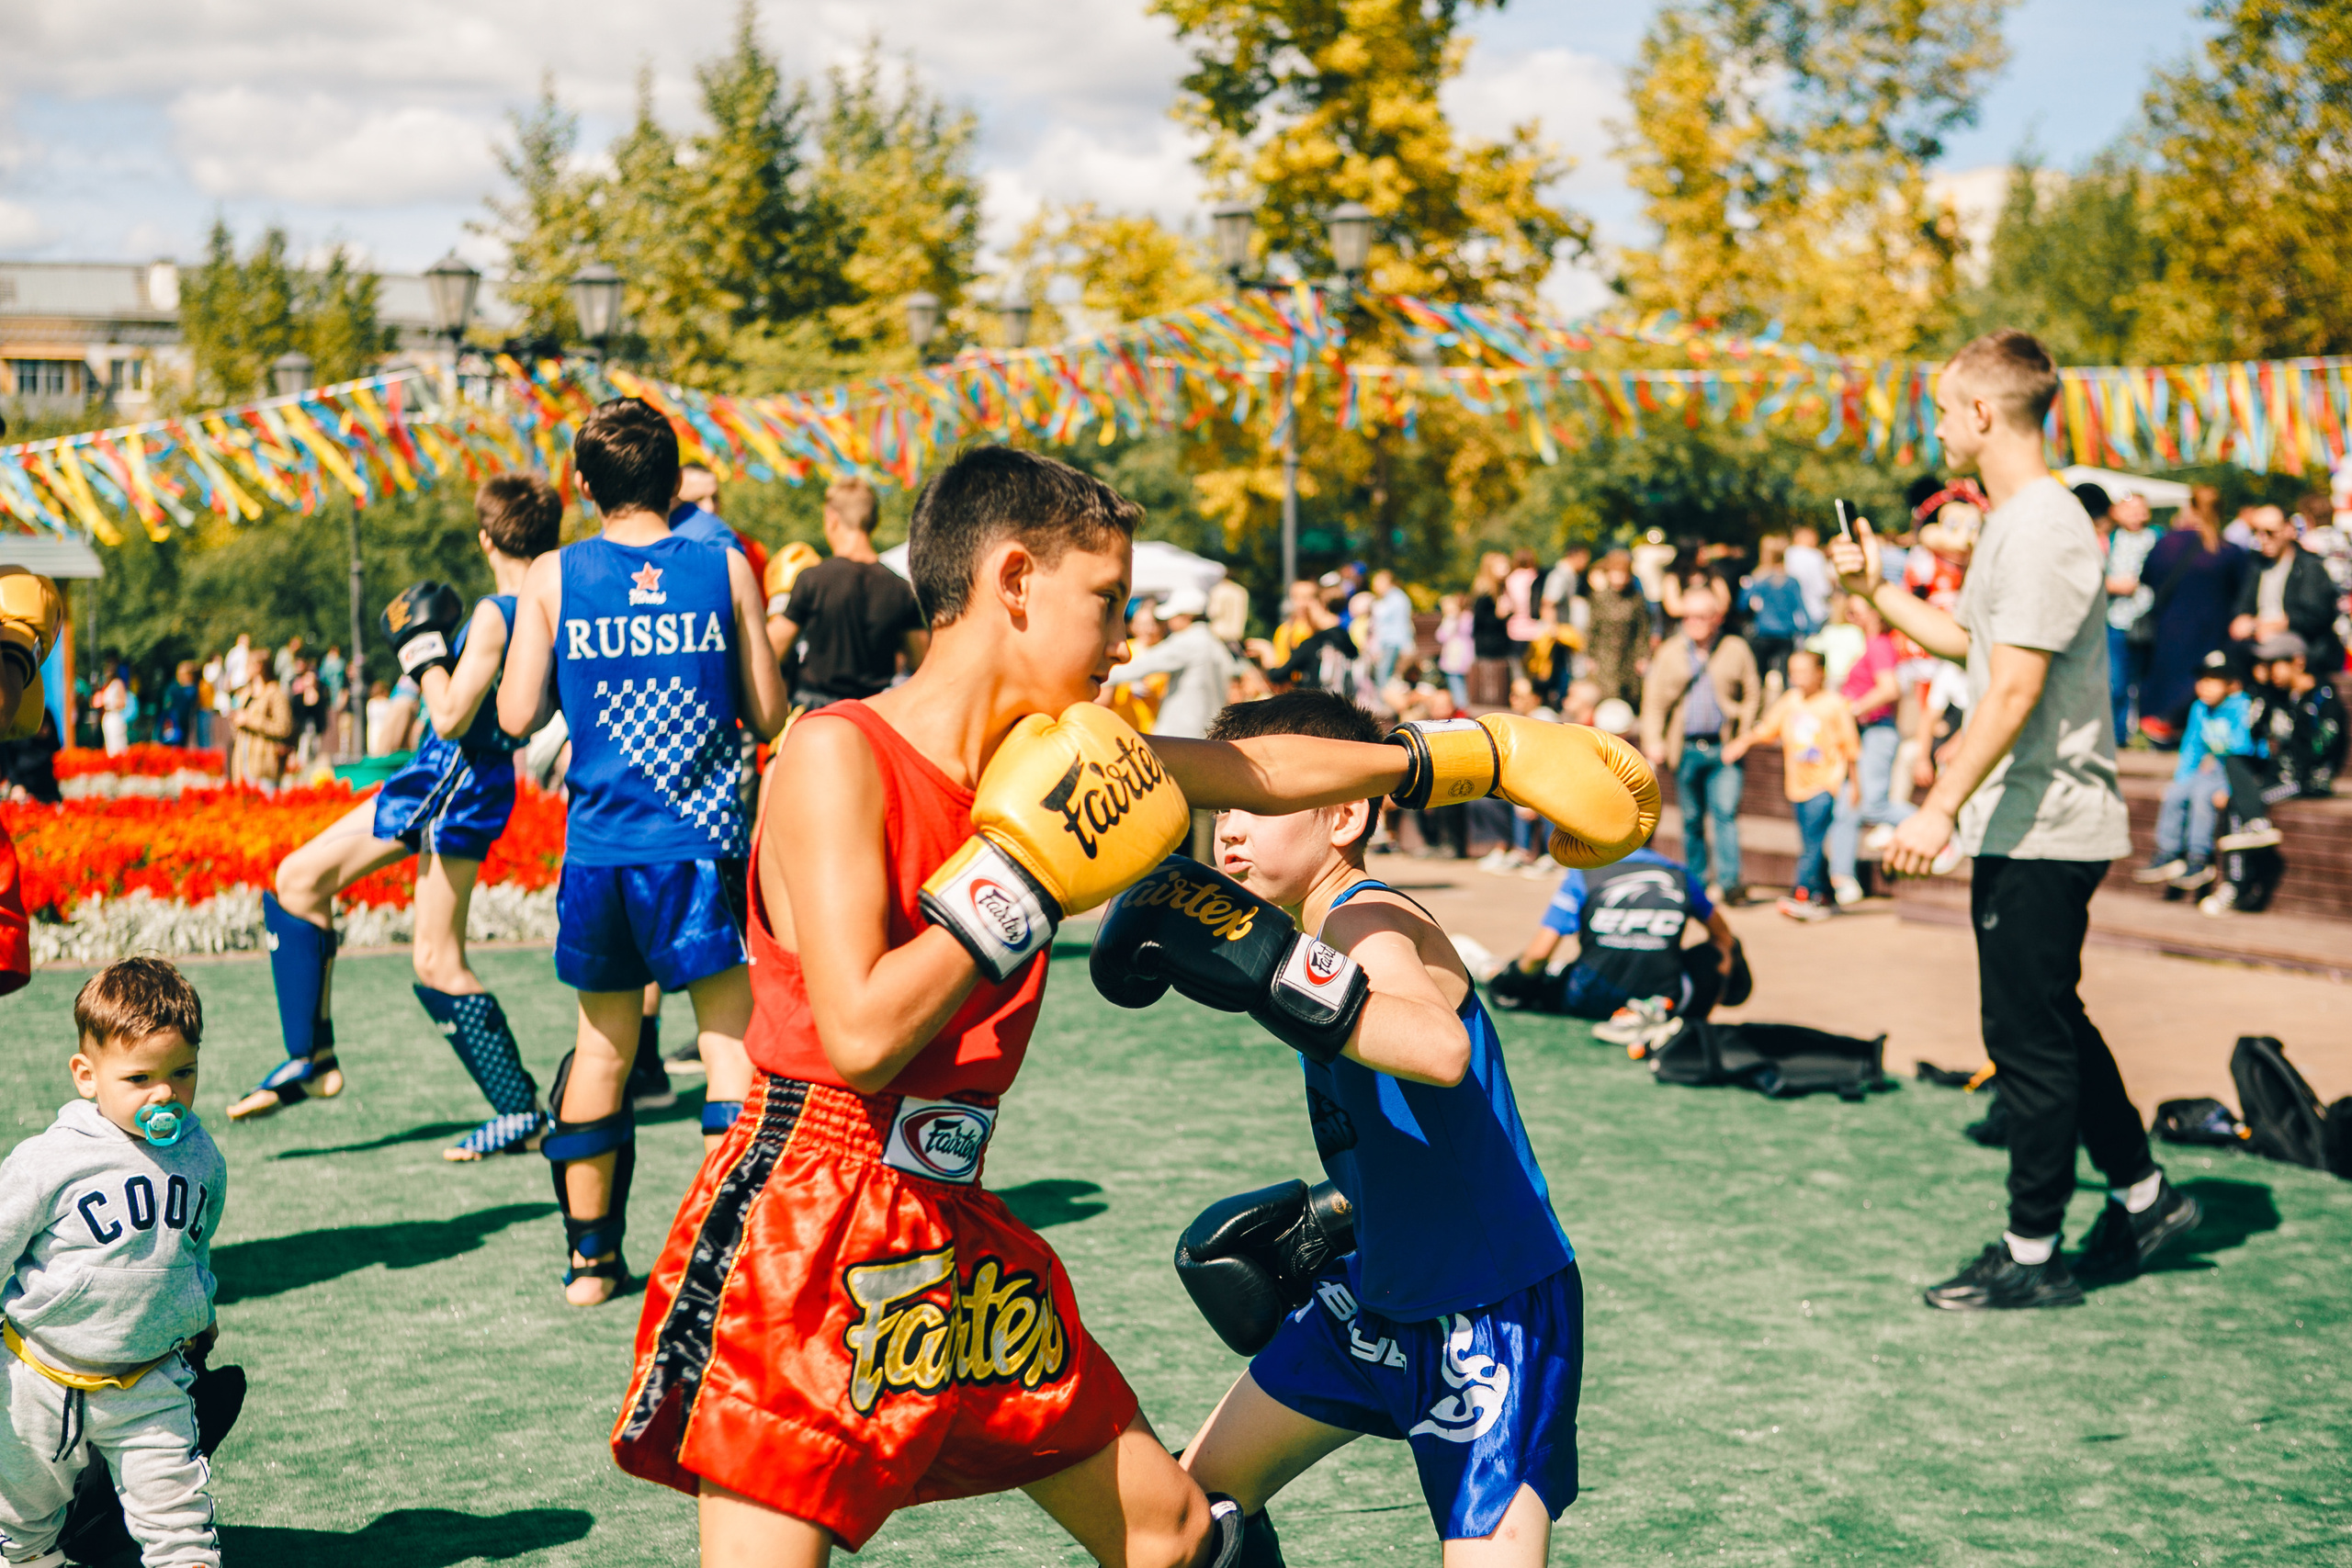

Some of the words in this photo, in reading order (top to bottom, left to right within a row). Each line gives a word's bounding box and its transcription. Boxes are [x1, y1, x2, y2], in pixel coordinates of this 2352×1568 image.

[565, 611, 726, 660] RUSSIA
[1039, 738, 1171, 860] Fairte
[1311, 943, 1337, 976] Fairt
[76, 1173, 208, 1246] COOL
